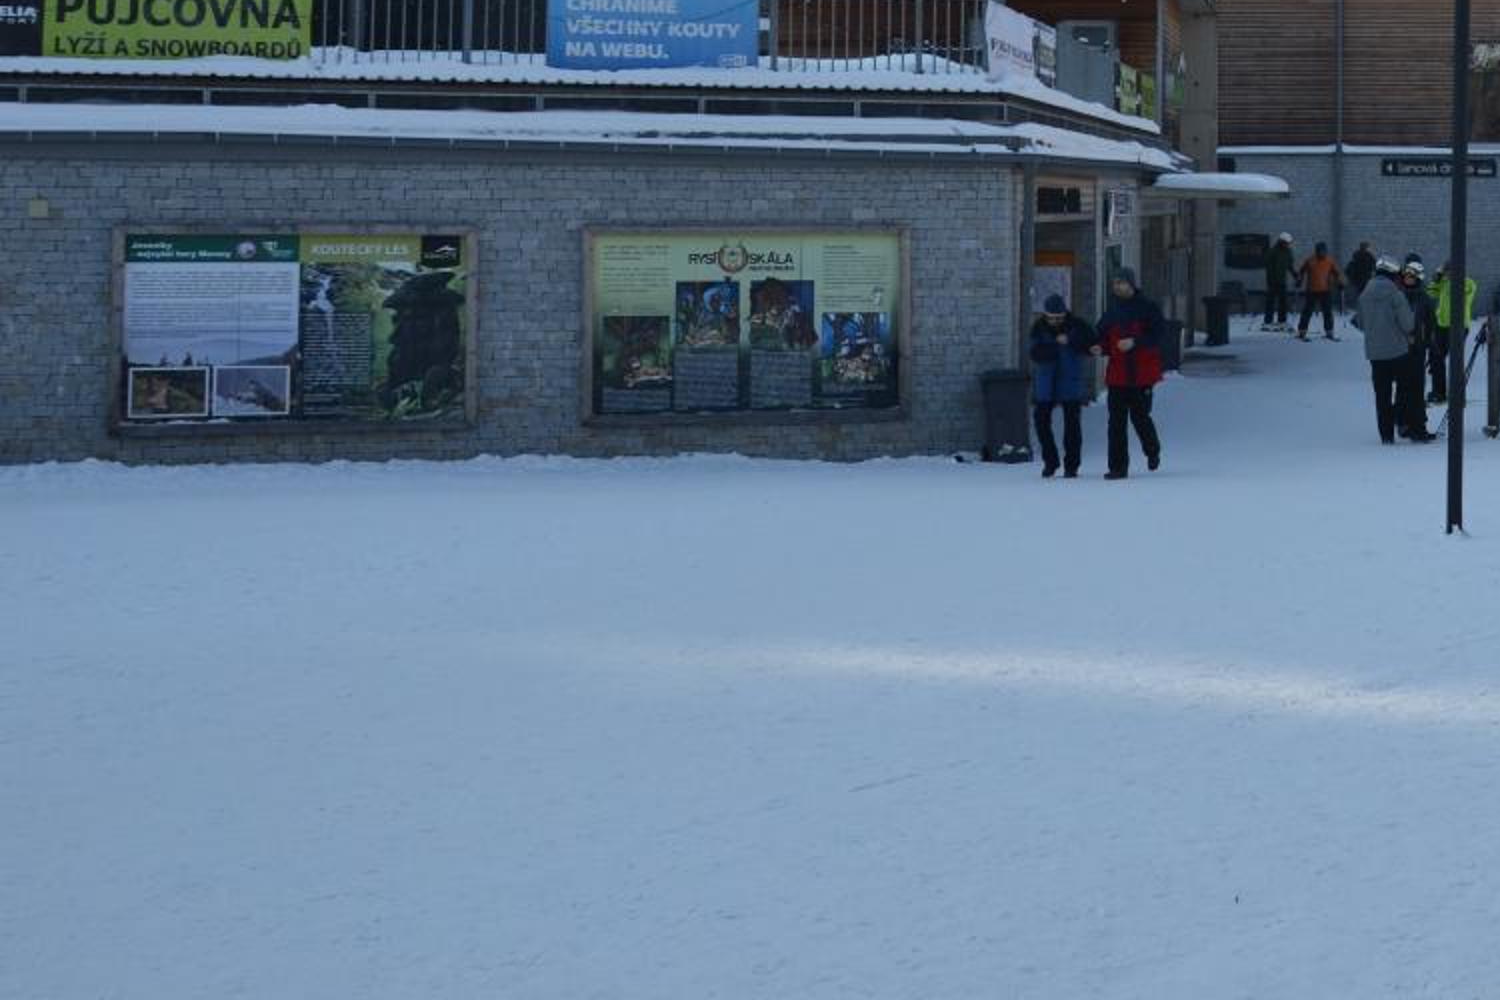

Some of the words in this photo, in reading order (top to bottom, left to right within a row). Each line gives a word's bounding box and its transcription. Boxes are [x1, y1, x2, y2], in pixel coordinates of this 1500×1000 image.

[566, 14, 664, 36] VŠECHNY
[669, 21, 741, 38] KOUTY
[54, 31, 105, 55] LYŽÍ
[115, 41, 129, 56] A
[565, 41, 596, 57] NA
[602, 42, 670, 59] WEBU.
